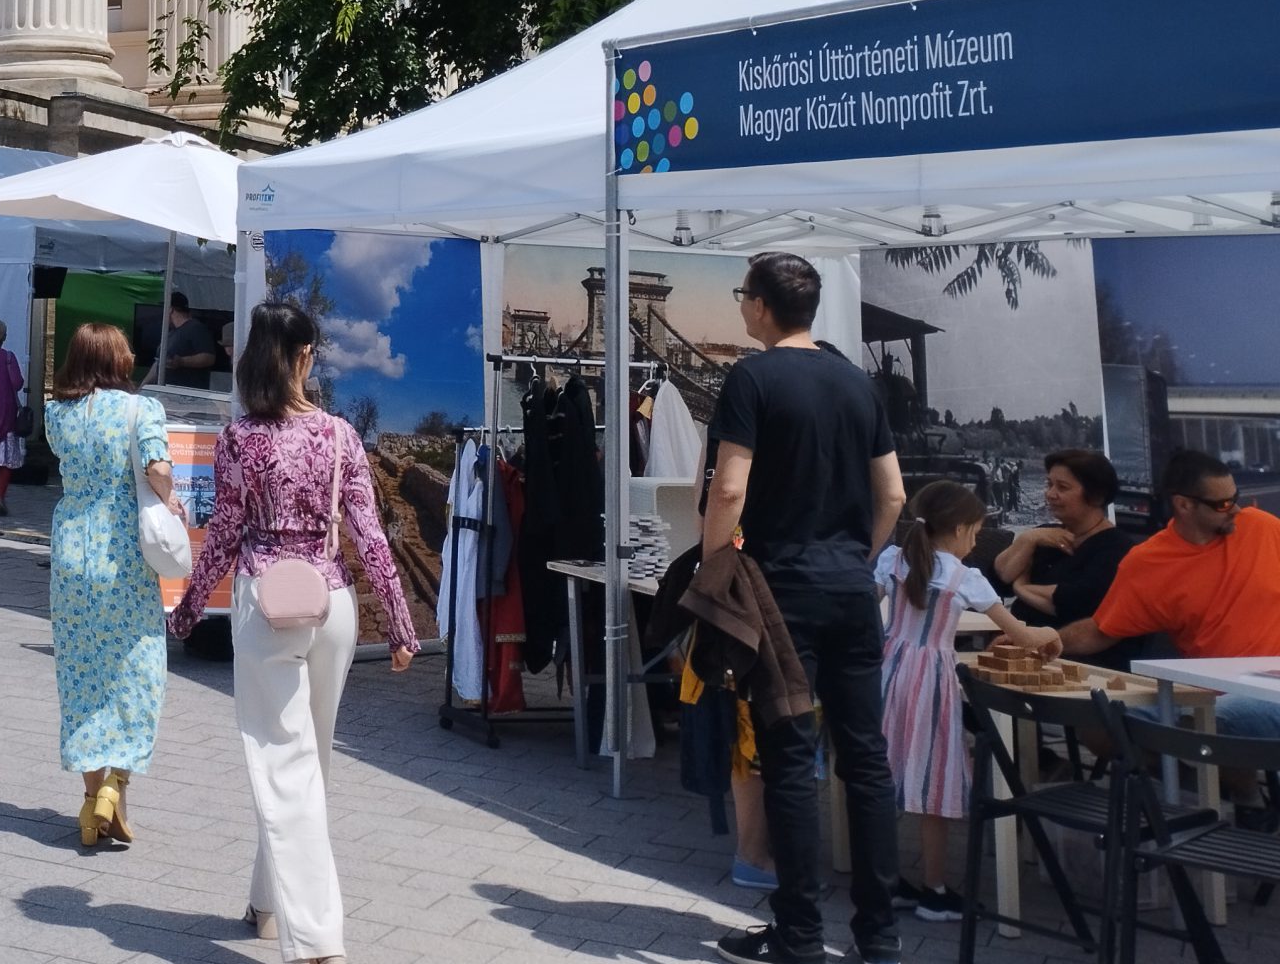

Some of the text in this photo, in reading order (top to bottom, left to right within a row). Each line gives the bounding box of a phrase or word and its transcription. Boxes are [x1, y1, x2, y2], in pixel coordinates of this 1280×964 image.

[738, 29, 1014, 92] Kiskőrösi Úttörténeti Múzeum
[739, 80, 994, 142] Magyar Közút Nonprofit Zrt.
